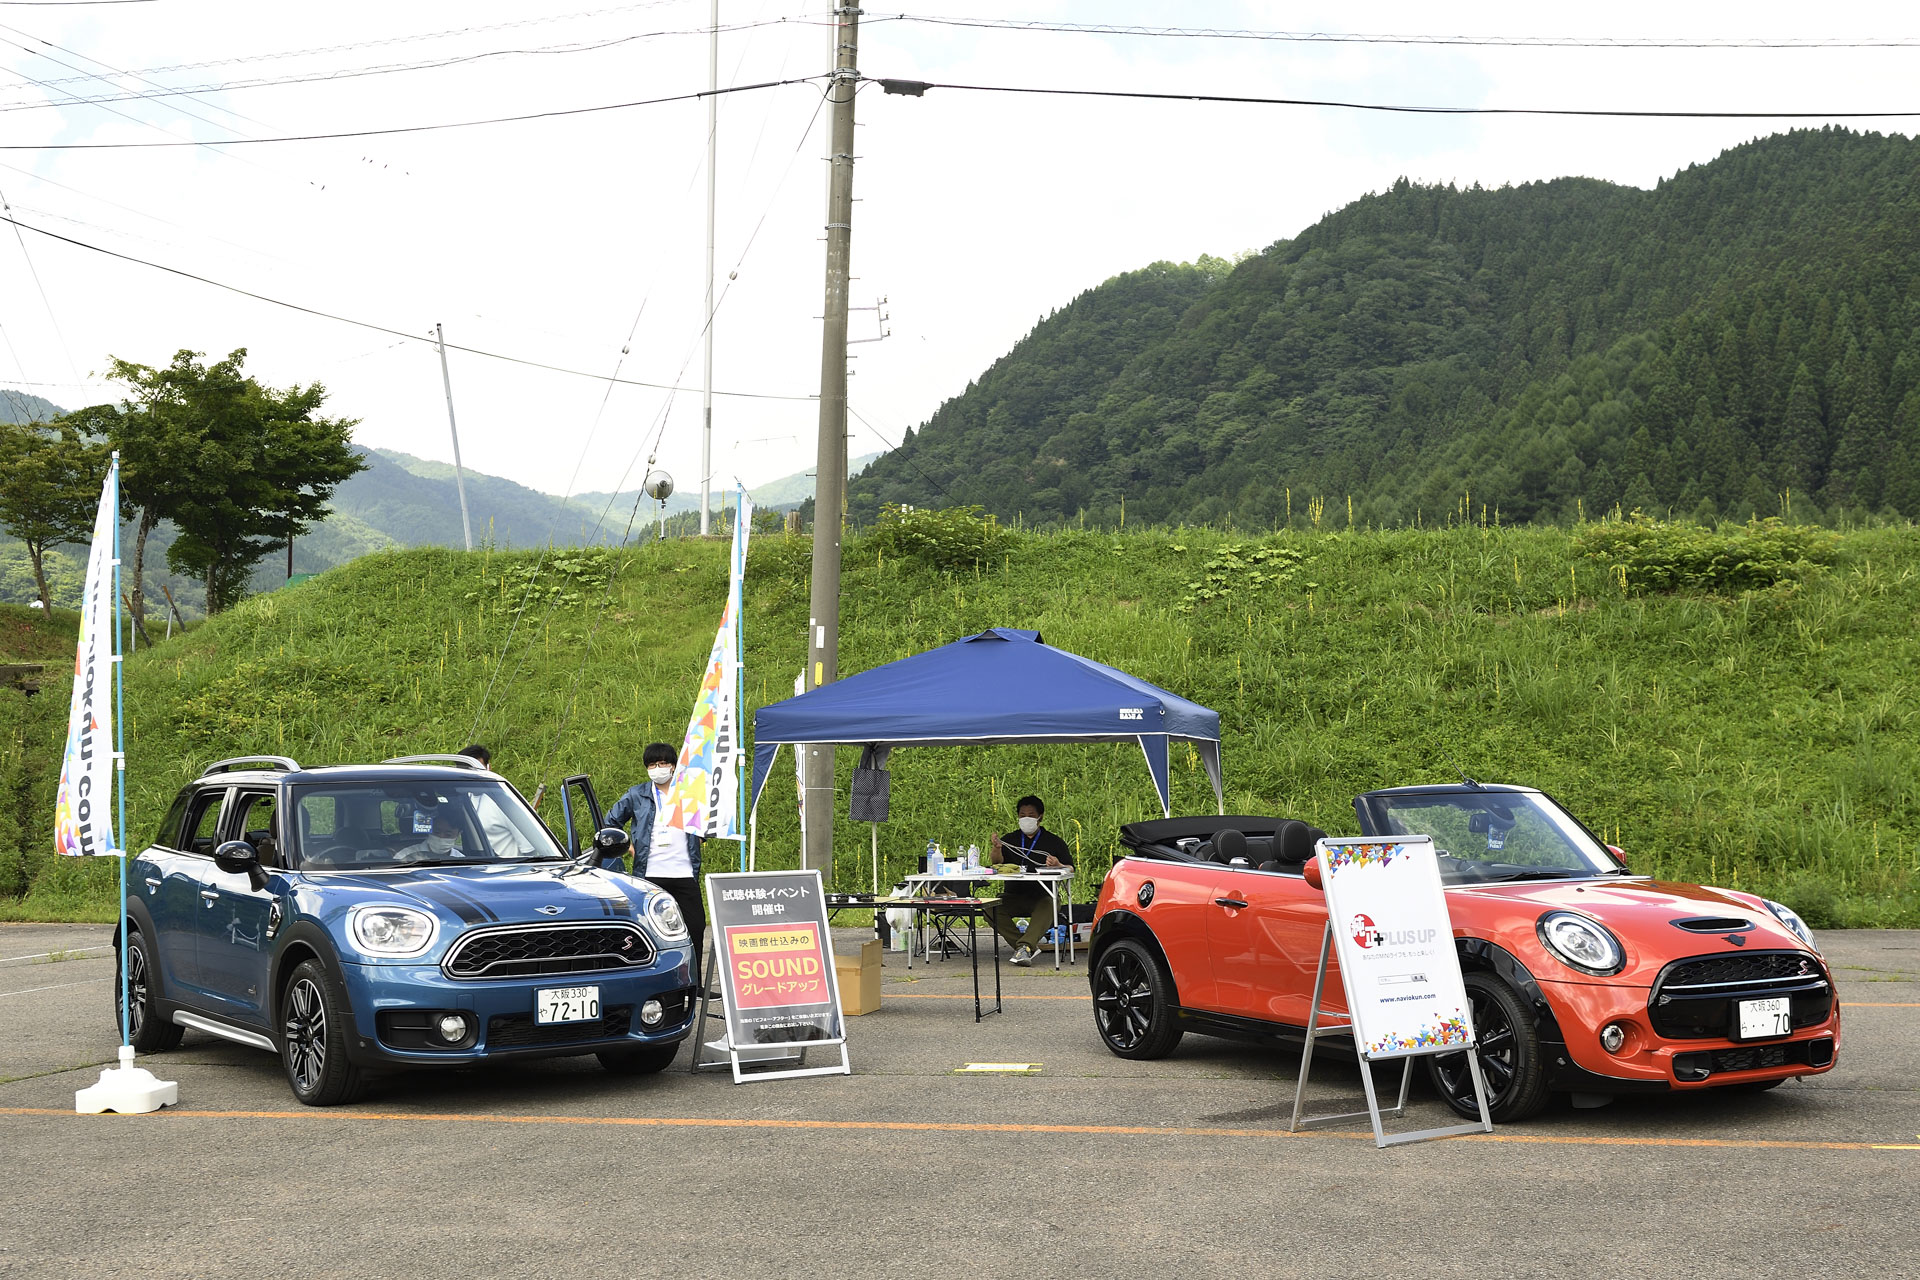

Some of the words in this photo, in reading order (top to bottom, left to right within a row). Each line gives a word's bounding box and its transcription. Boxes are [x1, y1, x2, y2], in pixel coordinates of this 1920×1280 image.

[722, 886, 810, 901] 試聴体験イベント
[752, 903, 785, 916] 開催中
[739, 935, 809, 948] 映画館仕込みの
[1418, 928, 1437, 944] UP
[737, 957, 819, 980] SOUND
[551, 988, 587, 1000] 大阪330
[741, 978, 820, 996] グレードアップ
[1380, 993, 1437, 1003] www.naviokun.com
[539, 1008, 548, 1017] や
[550, 1000, 598, 1021] 72-10
[1750, 1000, 1781, 1013] 大阪360
